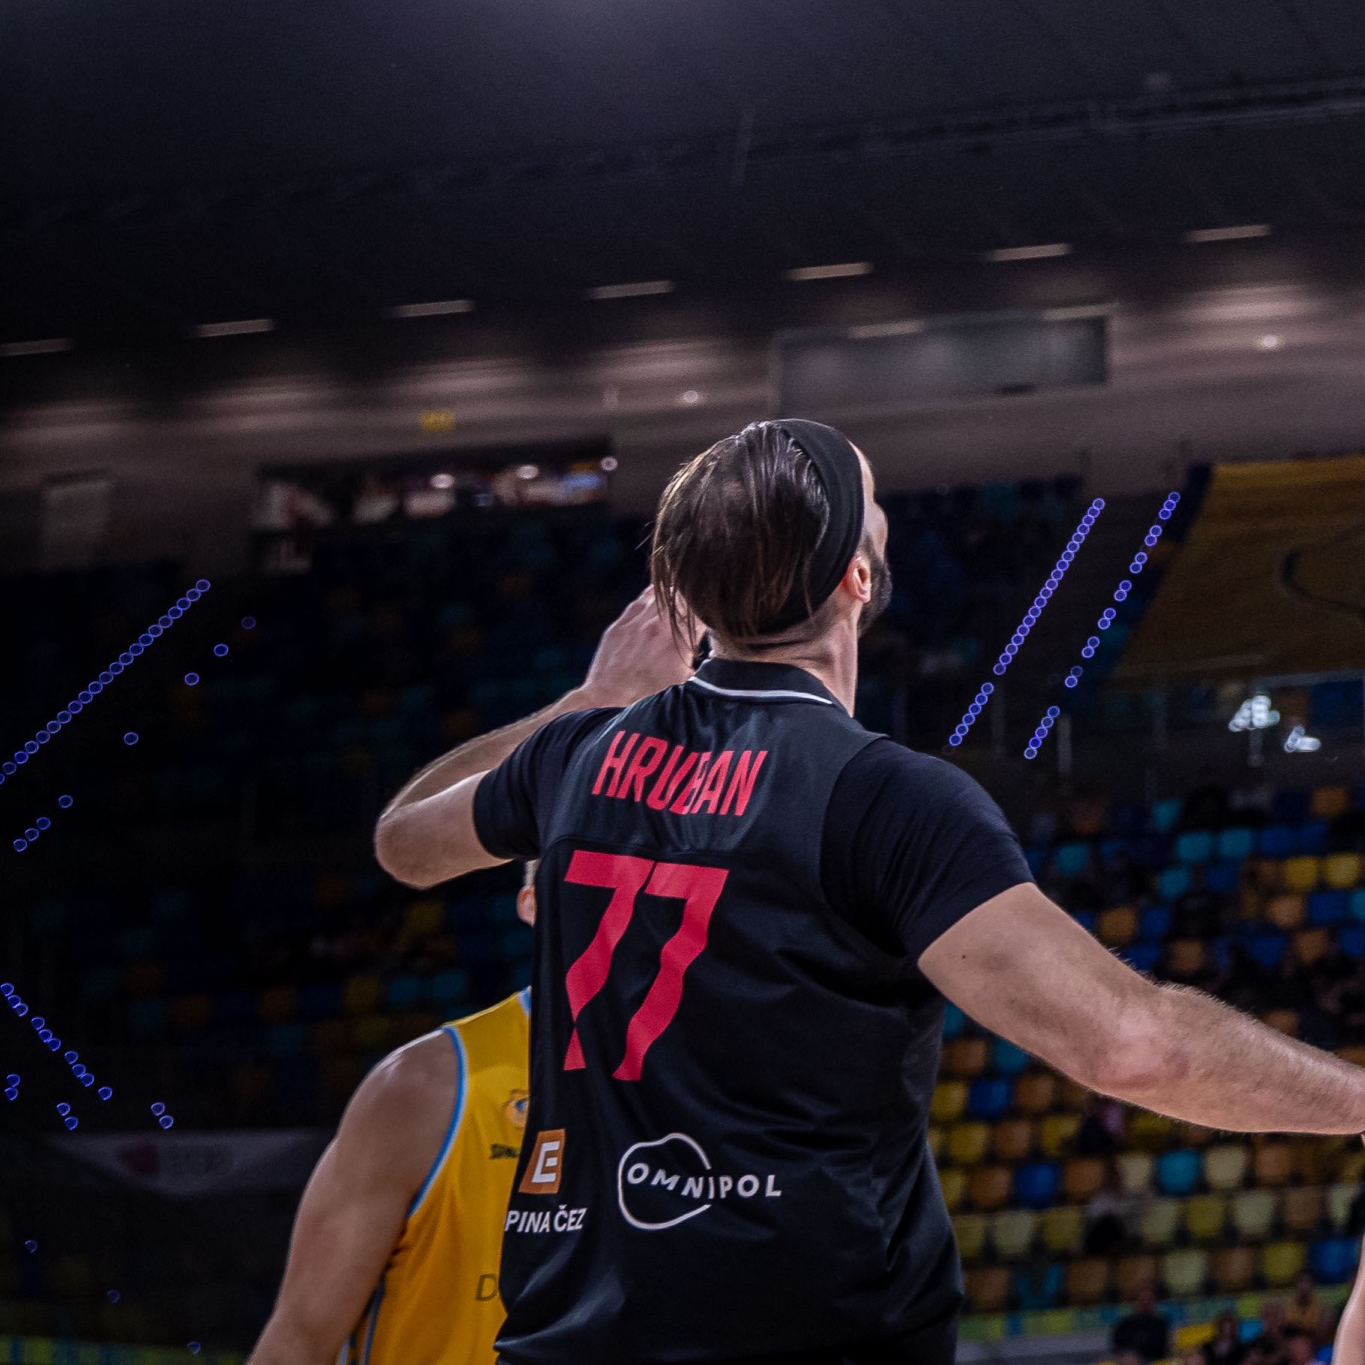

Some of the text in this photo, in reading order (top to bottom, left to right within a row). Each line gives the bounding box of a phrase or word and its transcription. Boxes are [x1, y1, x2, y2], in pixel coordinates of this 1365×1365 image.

[593, 731, 767, 817] HRUBAN
[563, 849, 730, 1081] 77
[626, 1163, 782, 1199] OMNIPOL
[553, 1204, 588, 1233] ČEZ
